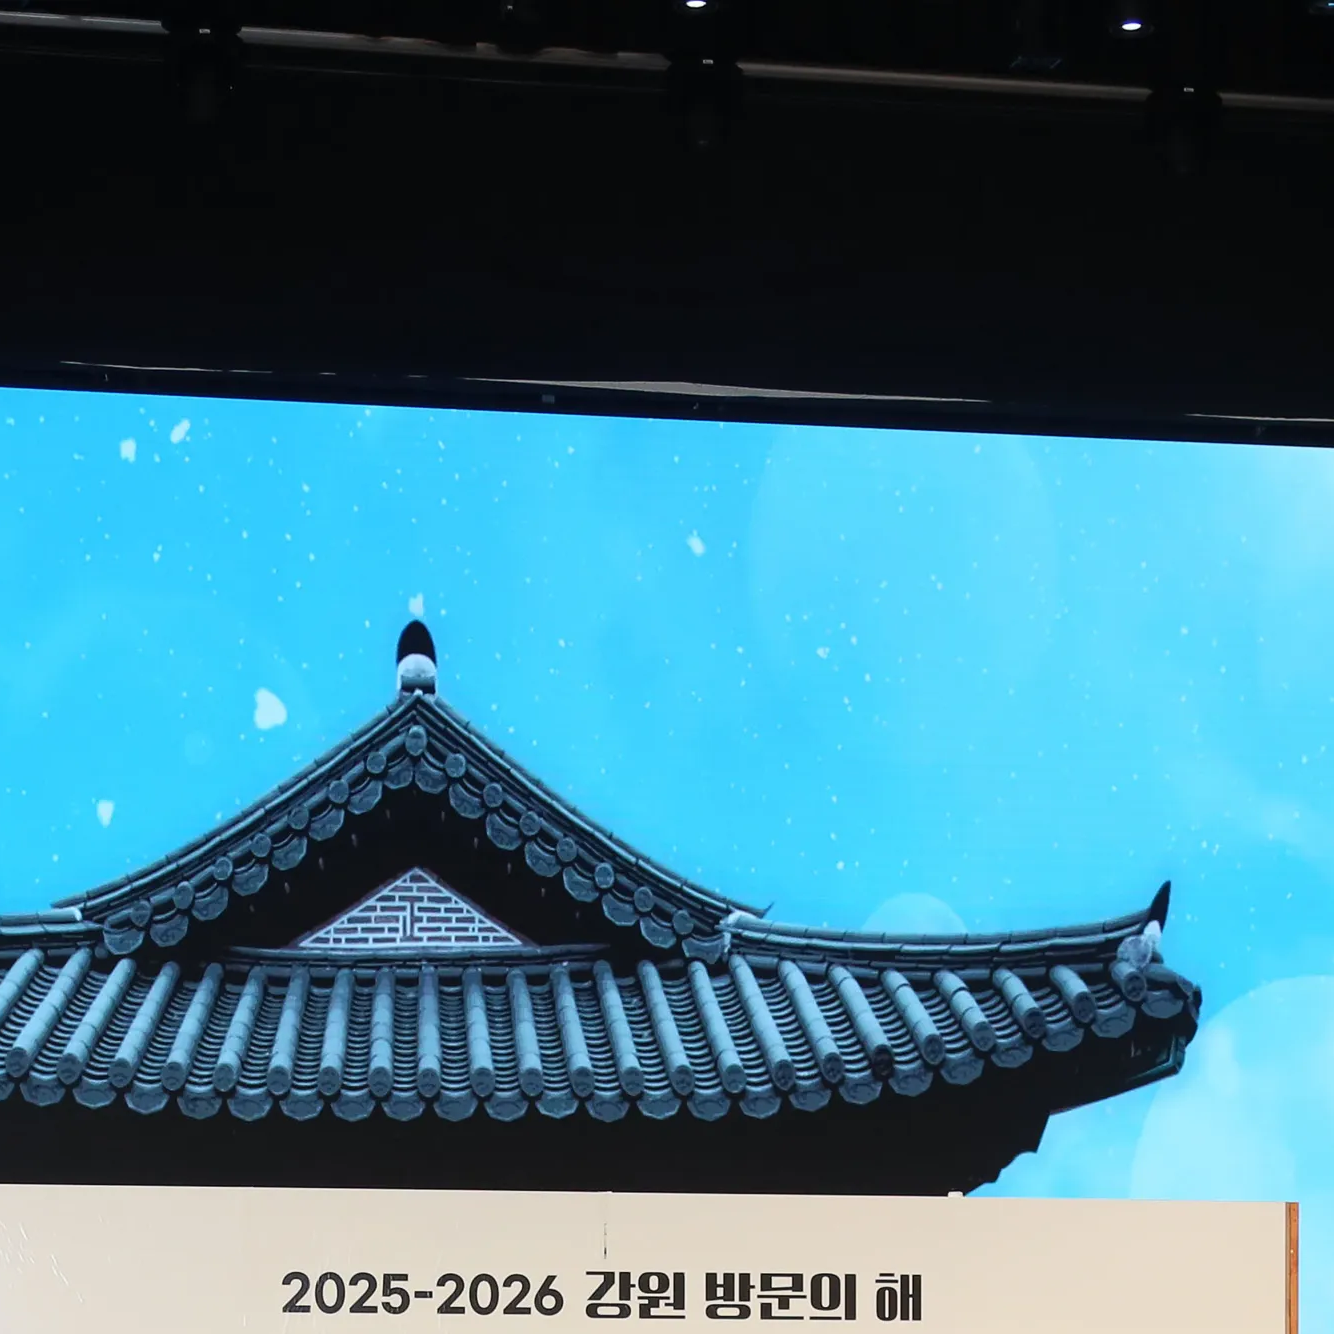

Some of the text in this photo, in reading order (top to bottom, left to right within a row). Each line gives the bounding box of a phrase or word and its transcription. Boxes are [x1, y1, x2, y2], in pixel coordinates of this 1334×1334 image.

[281, 1270, 923, 1322] 2025-2026 강원 방문의 해
